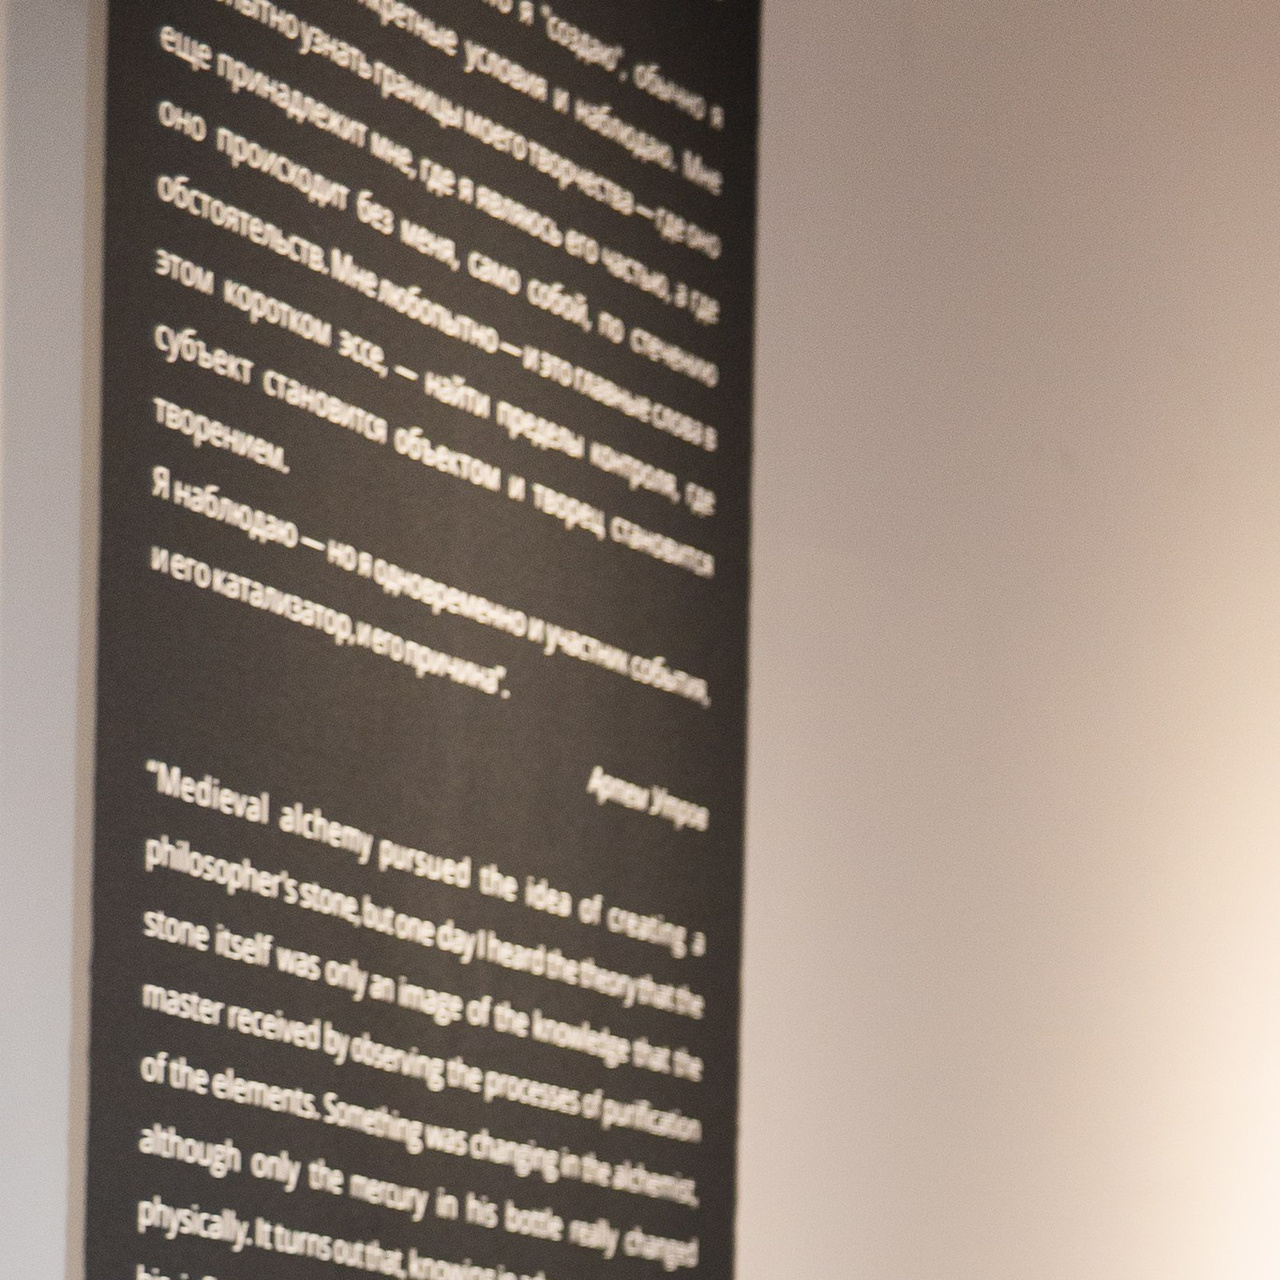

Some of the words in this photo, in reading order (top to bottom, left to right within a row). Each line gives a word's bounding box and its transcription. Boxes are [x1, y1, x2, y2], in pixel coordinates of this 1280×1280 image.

[158, 24, 213, 71] еще
[216, 52, 368, 148] принадлежит
[157, 99, 207, 142] оно
[215, 126, 350, 210] происходит
[355, 188, 394, 235] без
[154, 247, 214, 295] этом
[222, 278, 332, 347] коротком
[156, 174, 330, 275] обстоятельств.
[329, 247, 379, 300] Мне
[152, 396, 290, 474] творением.
[153, 323, 254, 384] субъект
[262, 368, 388, 444] становится
[393, 425, 501, 491] объектом
[507, 474, 526, 501] и
[149, 545, 170, 573] и
[169, 552, 212, 589] его
[151, 464, 170, 500] Я
[172, 480, 299, 548] наблюдаю
[326, 538, 358, 571] но
[144, 834, 299, 904] philosopher's
[298, 881, 362, 927] stone,
[360, 894, 395, 935] but
[393, 912, 436, 947] one
[435, 918, 477, 964] day
[278, 801, 374, 865] alchemy
[377, 838, 472, 888] pursued
[478, 863, 518, 902] the
[524, 875, 572, 917] idea
[577, 893, 603, 924] of
[605, 905, 687, 959] creating
[142, 910, 210, 952] stone
[214, 922, 274, 966] itself
[275, 946, 321, 981] was
[323, 958, 367, 1002] only
[368, 973, 395, 1002] an
[397, 975, 464, 1026] image
[465, 994, 492, 1026] of
[492, 1000, 530, 1038] the
[141, 983, 225, 1025] master
[226, 1004, 322, 1050] received
[322, 1020, 351, 1065] by
[349, 1031, 445, 1092] observing
[444, 1055, 484, 1093] the
[482, 1069, 582, 1115] processes
[139, 1050, 169, 1084] of
[167, 1055, 210, 1095] the
[210, 1067, 321, 1120] elements.
[322, 1091, 424, 1155] Something
[423, 1123, 469, 1156] was
[468, 1127, 560, 1183] changing
[136, 1194, 253, 1253] physically.
[254, 1216, 274, 1250] It
[273, 1222, 332, 1261] turns
[137, 1122, 242, 1179] although
[249, 1149, 301, 1193] only
[307, 1157, 344, 1195] the
[348, 1173, 429, 1222] mercury
[434, 1186, 459, 1219] in
[464, 1191, 498, 1228] his
[503, 1199, 564, 1241] bottle
